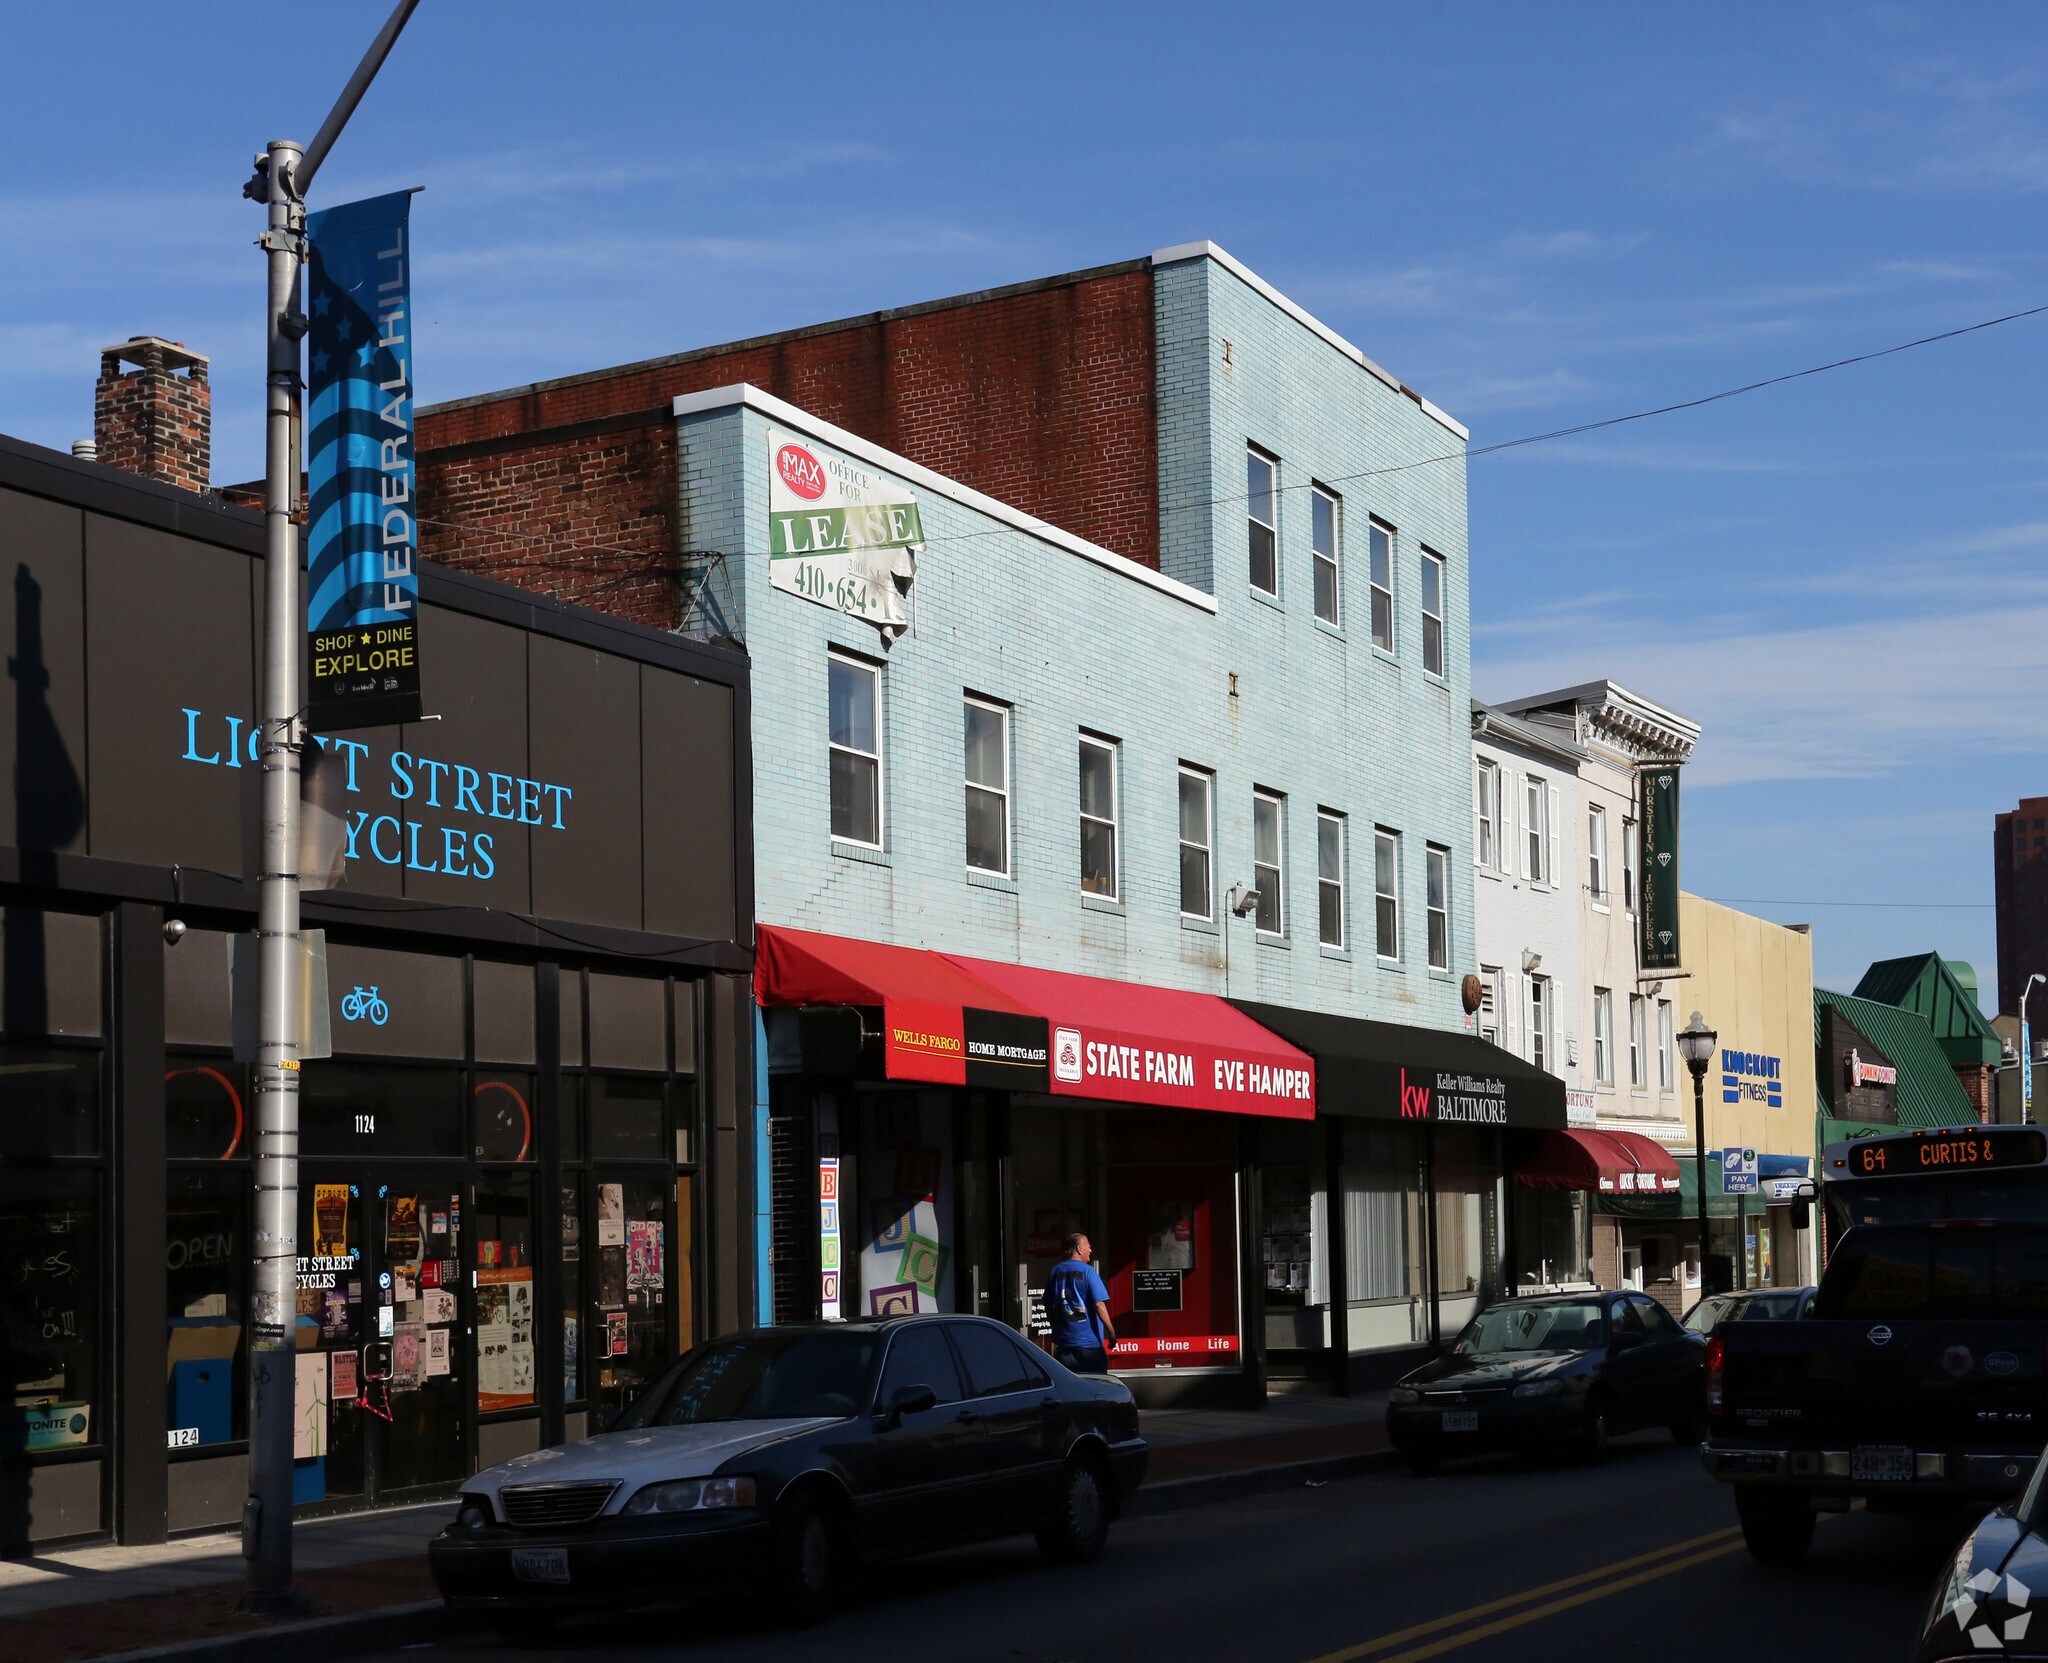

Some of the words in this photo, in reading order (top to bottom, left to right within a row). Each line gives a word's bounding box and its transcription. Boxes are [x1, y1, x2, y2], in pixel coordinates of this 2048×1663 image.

[377, 227, 405, 348] HILL
[782, 470, 806, 487] REALTY
[784, 451, 820, 485] MAX
[829, 460, 869, 490] OFFICE
[381, 359, 412, 612] FEDERAL
[839, 481, 861, 503] FOR
[779, 509, 914, 554] LEASE
[315, 634, 356, 652] SHOP
[377, 627, 413, 645] DINE
[315, 648, 414, 677] EXPLORE
[182, 707, 369, 793] LIT
[390, 751, 573, 830] STREET
[344, 809, 496, 880] YCLES
[1644, 874, 1655, 950] JEWELERS
[893, 1028, 928, 1046] WELLS
[929, 1033, 961, 1052] FARGO
[969, 1041, 996, 1056] HOME
[997, 1044, 1047, 1061] MORTGAGE
[1086, 1041, 1140, 1080] STATE
[1145, 1051, 1195, 1087] FARM
[1214, 1059, 1245, 1092] EVE
[1249, 1063, 1311, 1099] HAMPER
[1722, 1049, 1781, 1079] KNOCKOUT
[1437, 1073, 1457, 1091] Keller
[1457, 1076, 1485, 1094] Williams
[1486, 1079, 1506, 1099] Realty
[1739, 1082, 1767, 1102] FITNESS
[1437, 1095, 1507, 1123] BALTIMORE
[1566, 1093, 1594, 1108] ORTUNE
[355, 1115, 375, 1133] 1124
[1863, 1148, 1886, 1171] 64
[1920, 1142, 1977, 1165] CURTIS
[1983, 1140, 1994, 1160] &
[822, 1174, 833, 1193] B
[1619, 1173, 1634, 1189] LUCKY
[1731, 1175, 1749, 1183] PAY
[824, 1208, 832, 1227] J
[167, 1232, 232, 1270] OPEN
[825, 1242, 835, 1263] C
[312, 1256, 354, 1271] STREET
[911, 1248, 937, 1282] C
[825, 1277, 834, 1297] C
[1112, 1342, 1139, 1352] Auto
[1157, 1340, 1190, 1351] Home
[1208, 1338, 1230, 1350] Life
[334, 1354, 356, 1365] WANTED
[1736, 1408, 1803, 1418] FRONTIER
